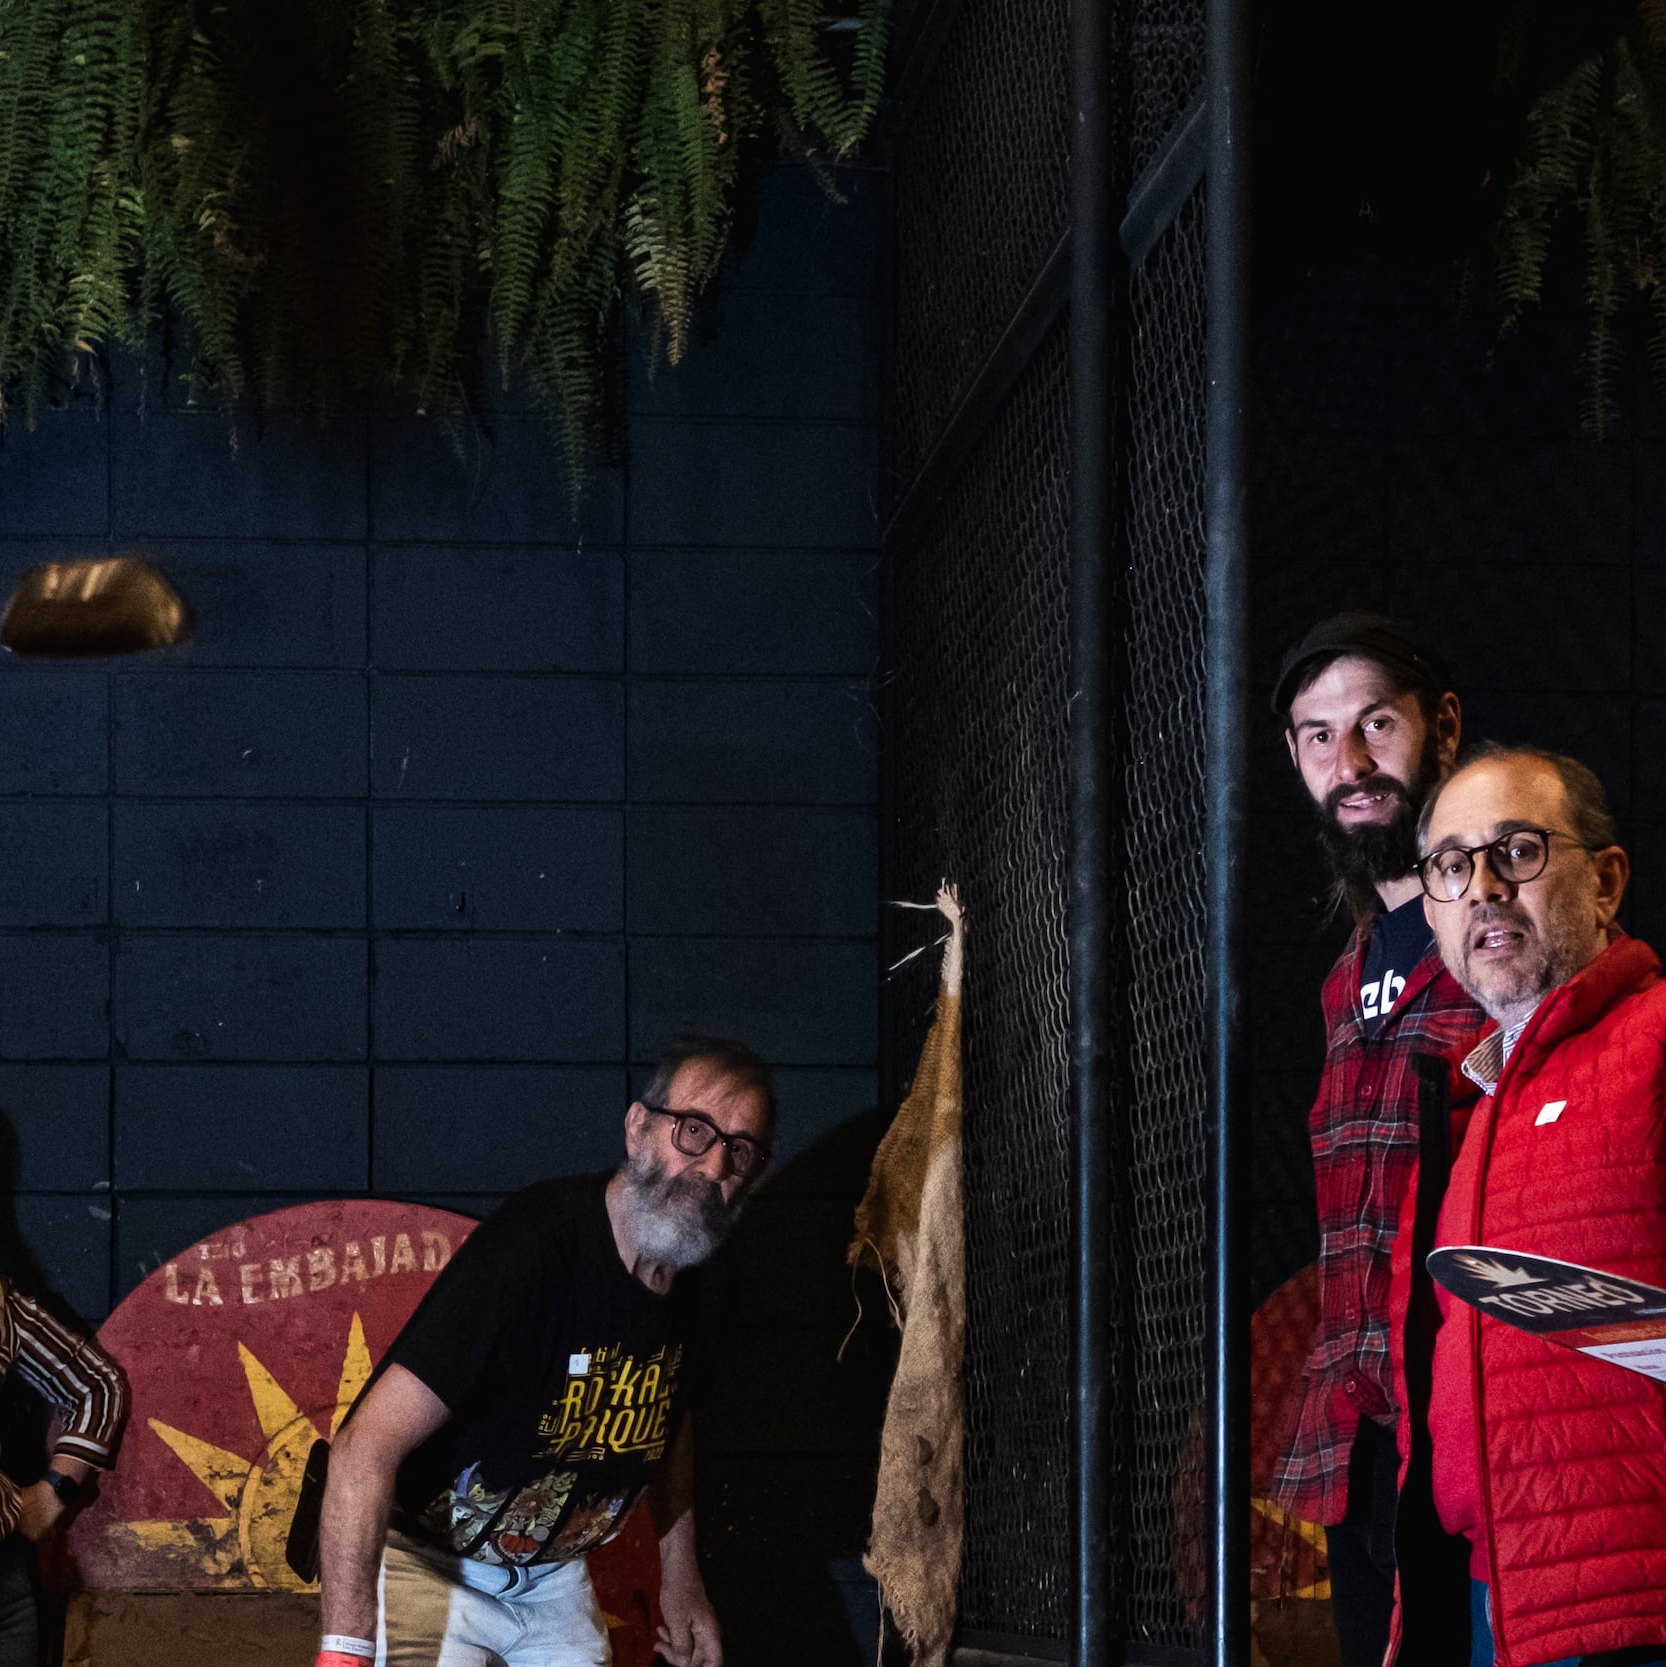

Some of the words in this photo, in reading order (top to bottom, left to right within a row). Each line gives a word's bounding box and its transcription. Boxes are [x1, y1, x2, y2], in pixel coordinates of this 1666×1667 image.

[164, 1263, 224, 1306] LA
[240, 1231, 467, 1305] EMBAJAD
[1478, 1276, 1645, 1318] TORNEO
